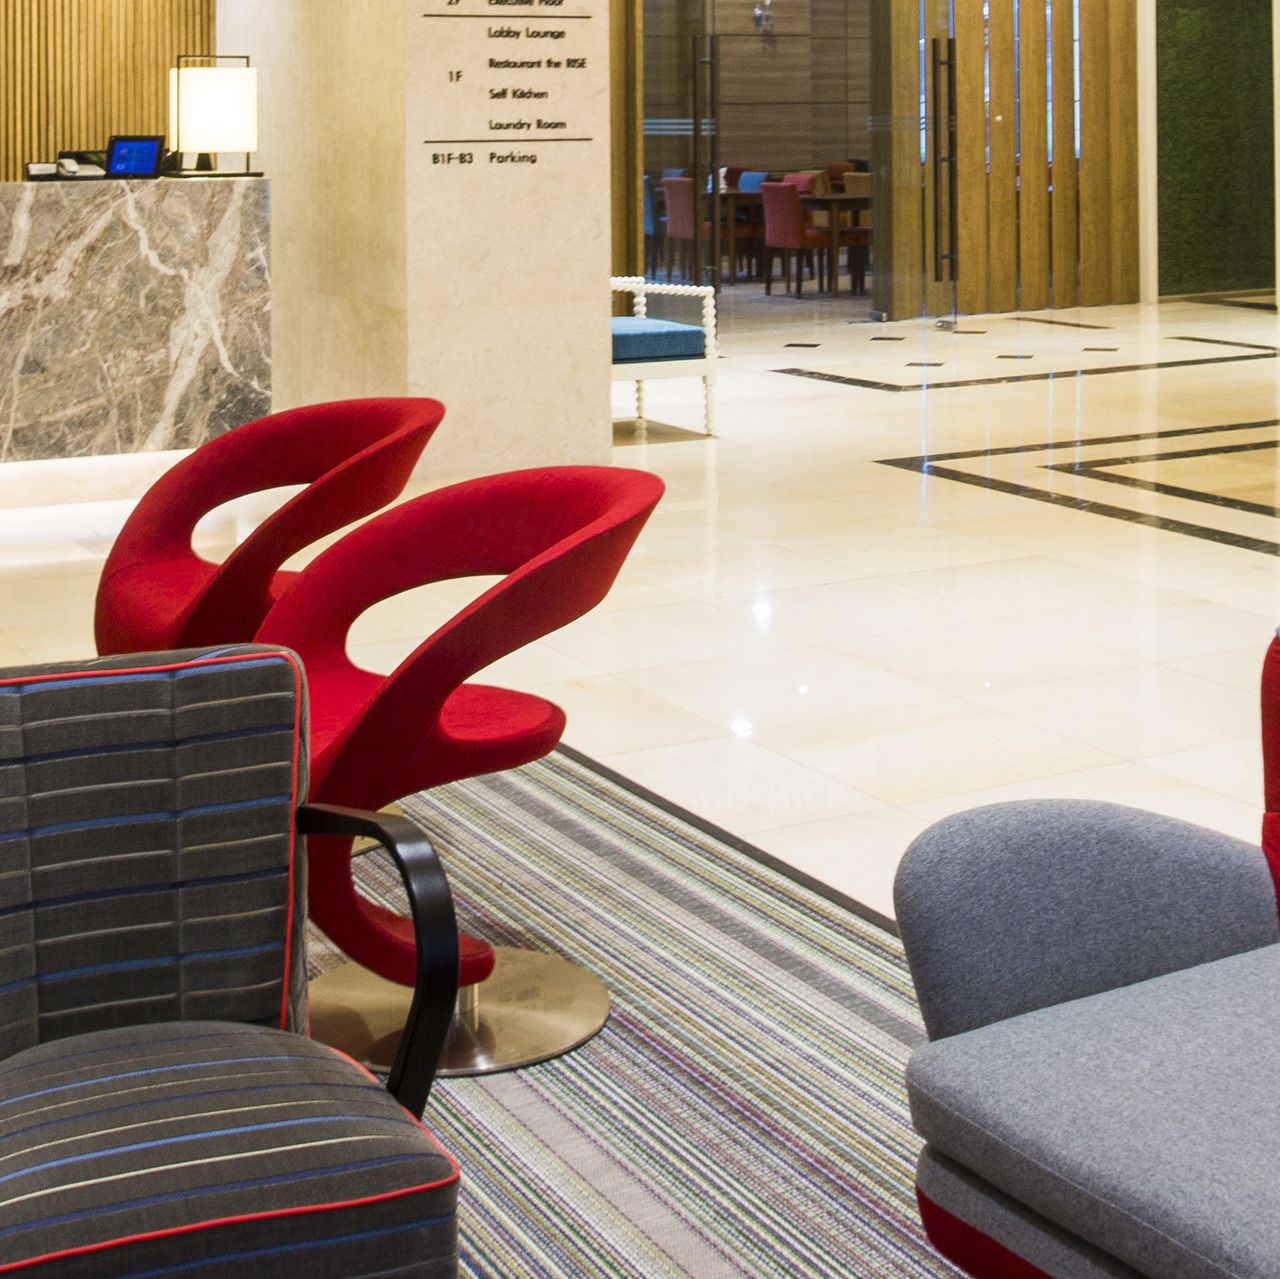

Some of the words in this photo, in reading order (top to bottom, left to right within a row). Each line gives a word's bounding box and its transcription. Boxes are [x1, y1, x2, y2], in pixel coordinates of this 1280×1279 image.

[488, 26, 521, 40] Lobby
[525, 27, 566, 40] Lounge
[488, 57, 542, 69] Restaurant
[546, 58, 562, 68] the
[566, 58, 588, 69] RISE
[448, 71, 463, 82] 1F
[489, 88, 508, 99] Self
[512, 88, 549, 99] Kitchen
[489, 119, 532, 131] Laundry
[536, 119, 567, 130] Room
[432, 152, 474, 164] B1F-B3
[489, 151, 537, 164] Parking
